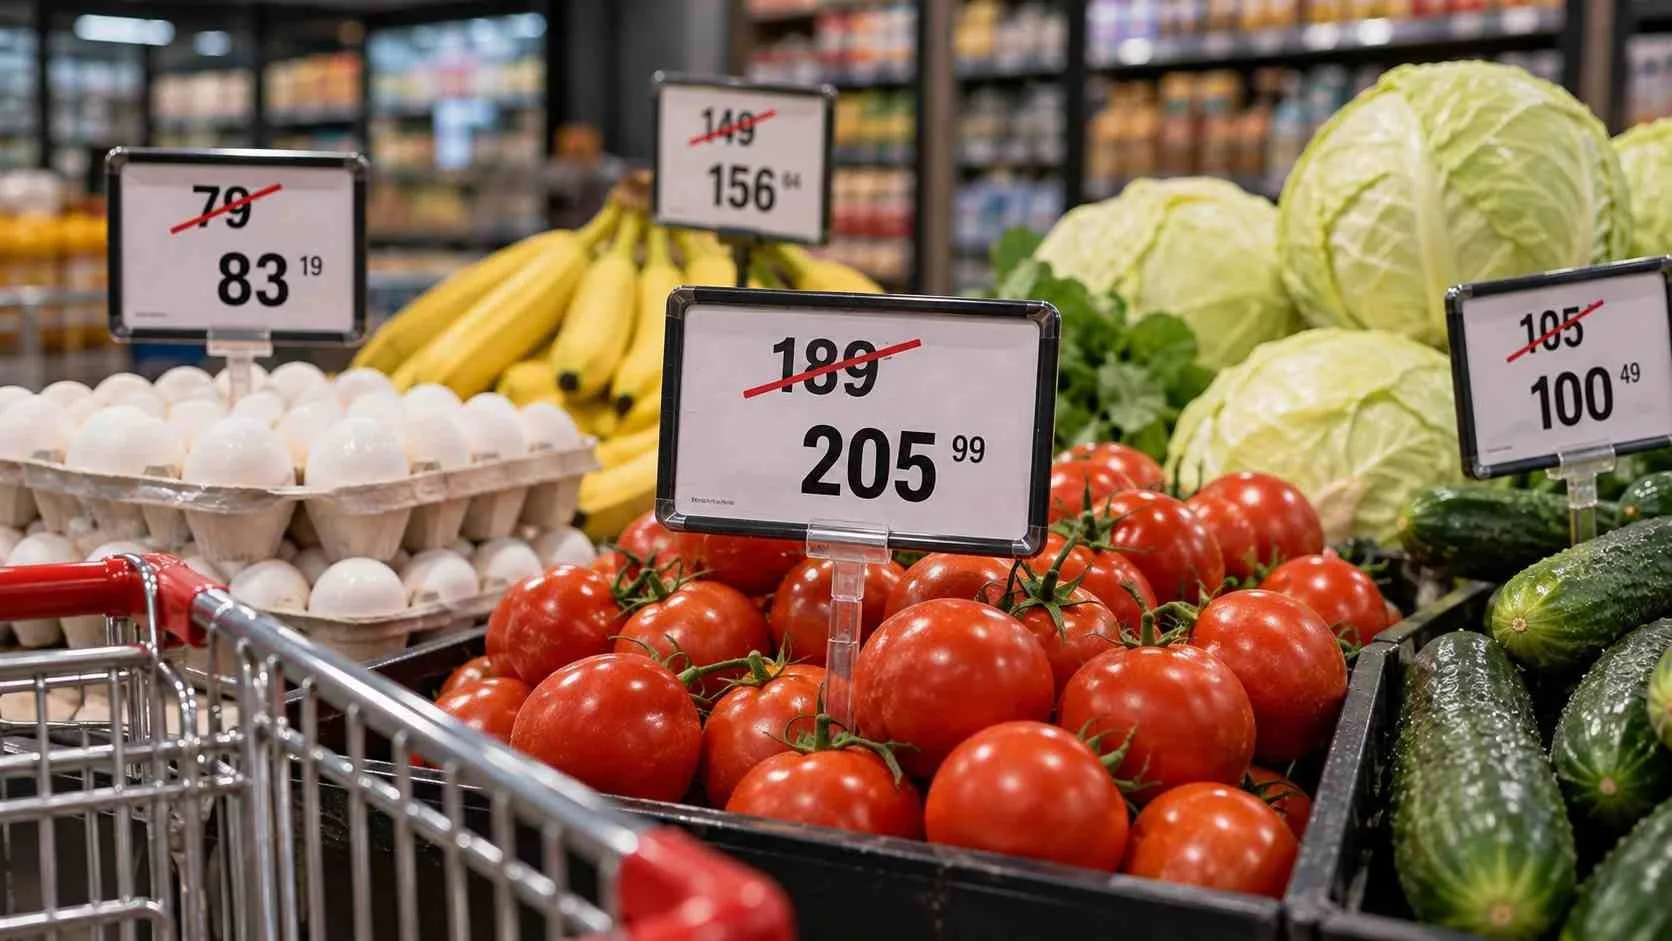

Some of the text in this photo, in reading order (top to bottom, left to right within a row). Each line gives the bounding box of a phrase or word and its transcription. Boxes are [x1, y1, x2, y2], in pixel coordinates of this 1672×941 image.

[702, 107, 755, 146] 149
[193, 185, 251, 229] 79
[709, 164, 776, 212] 156
[217, 252, 323, 308] 83 19
[1519, 305, 1584, 354] 105
[772, 336, 879, 397] 189
[1530, 361, 1641, 430] 100 49
[801, 424, 986, 503] 205 99
